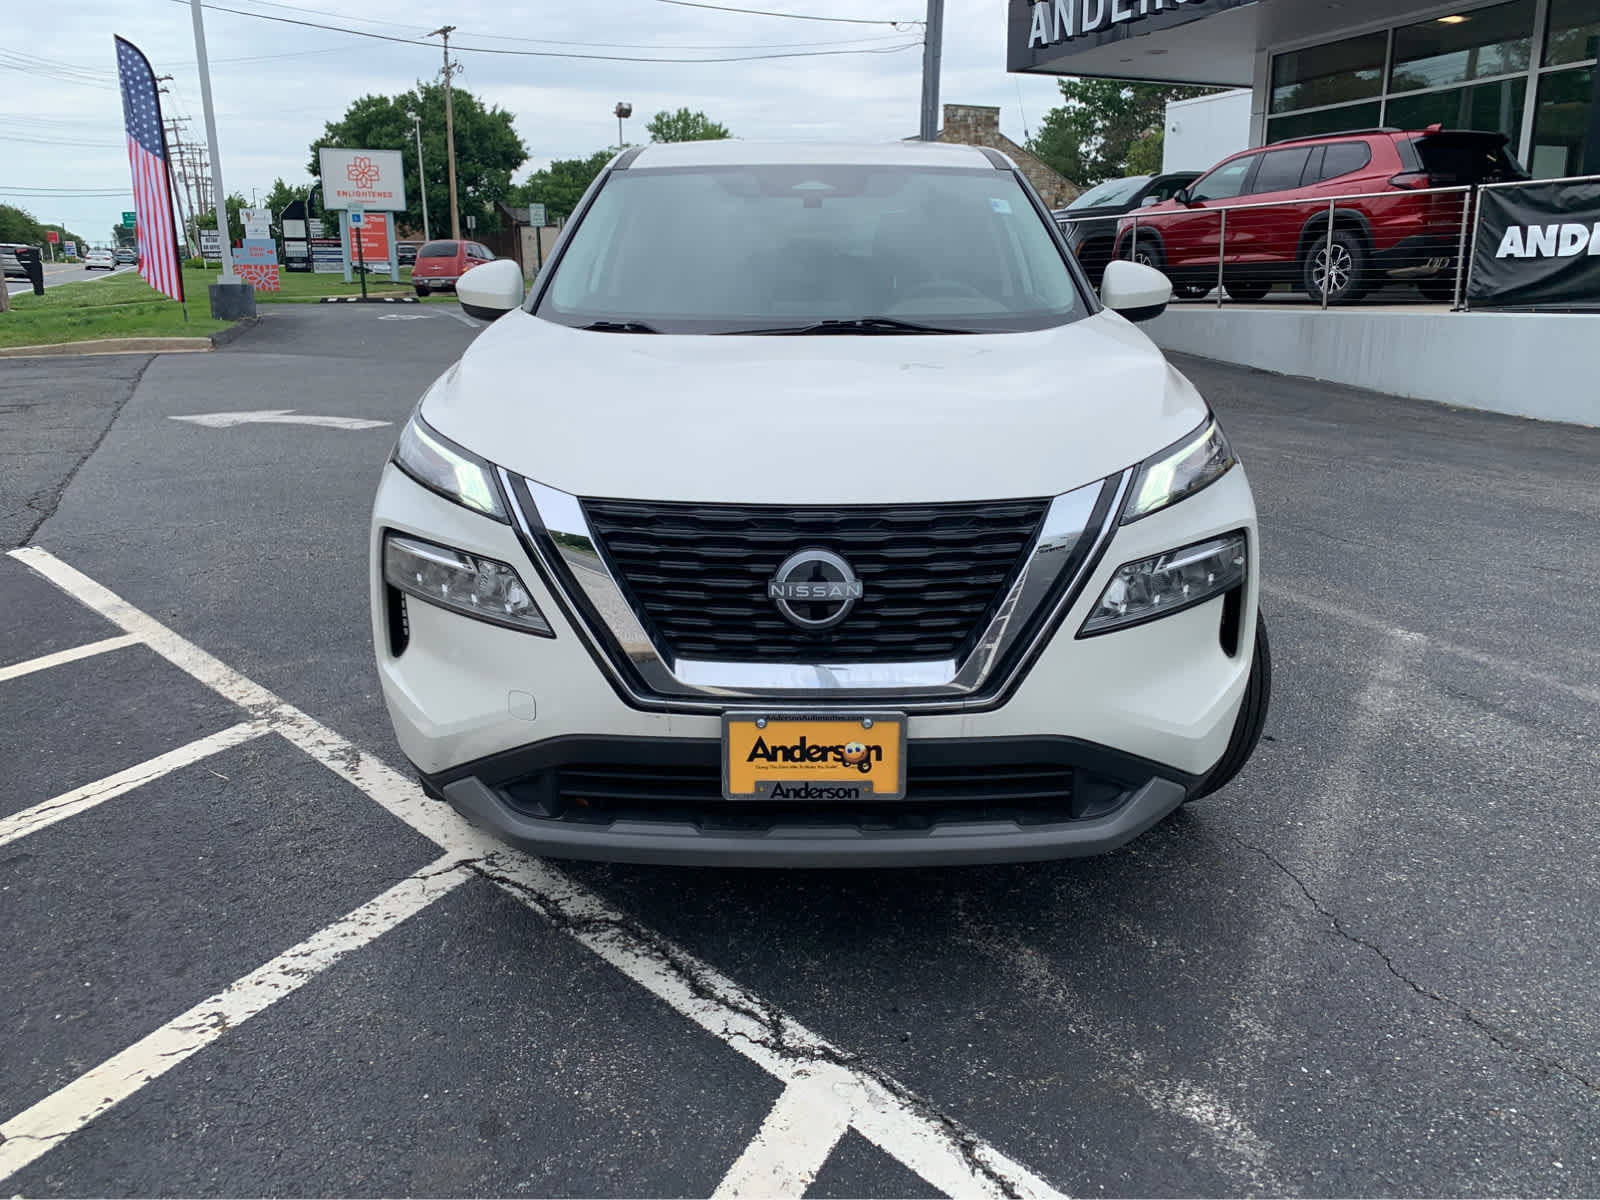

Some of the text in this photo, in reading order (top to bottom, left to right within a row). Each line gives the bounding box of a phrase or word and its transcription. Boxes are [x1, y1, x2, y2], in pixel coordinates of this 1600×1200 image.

[336, 190, 393, 199] ENLIGHTENED
[771, 584, 860, 597] NISSAN
[770, 781, 860, 799] Anderson
